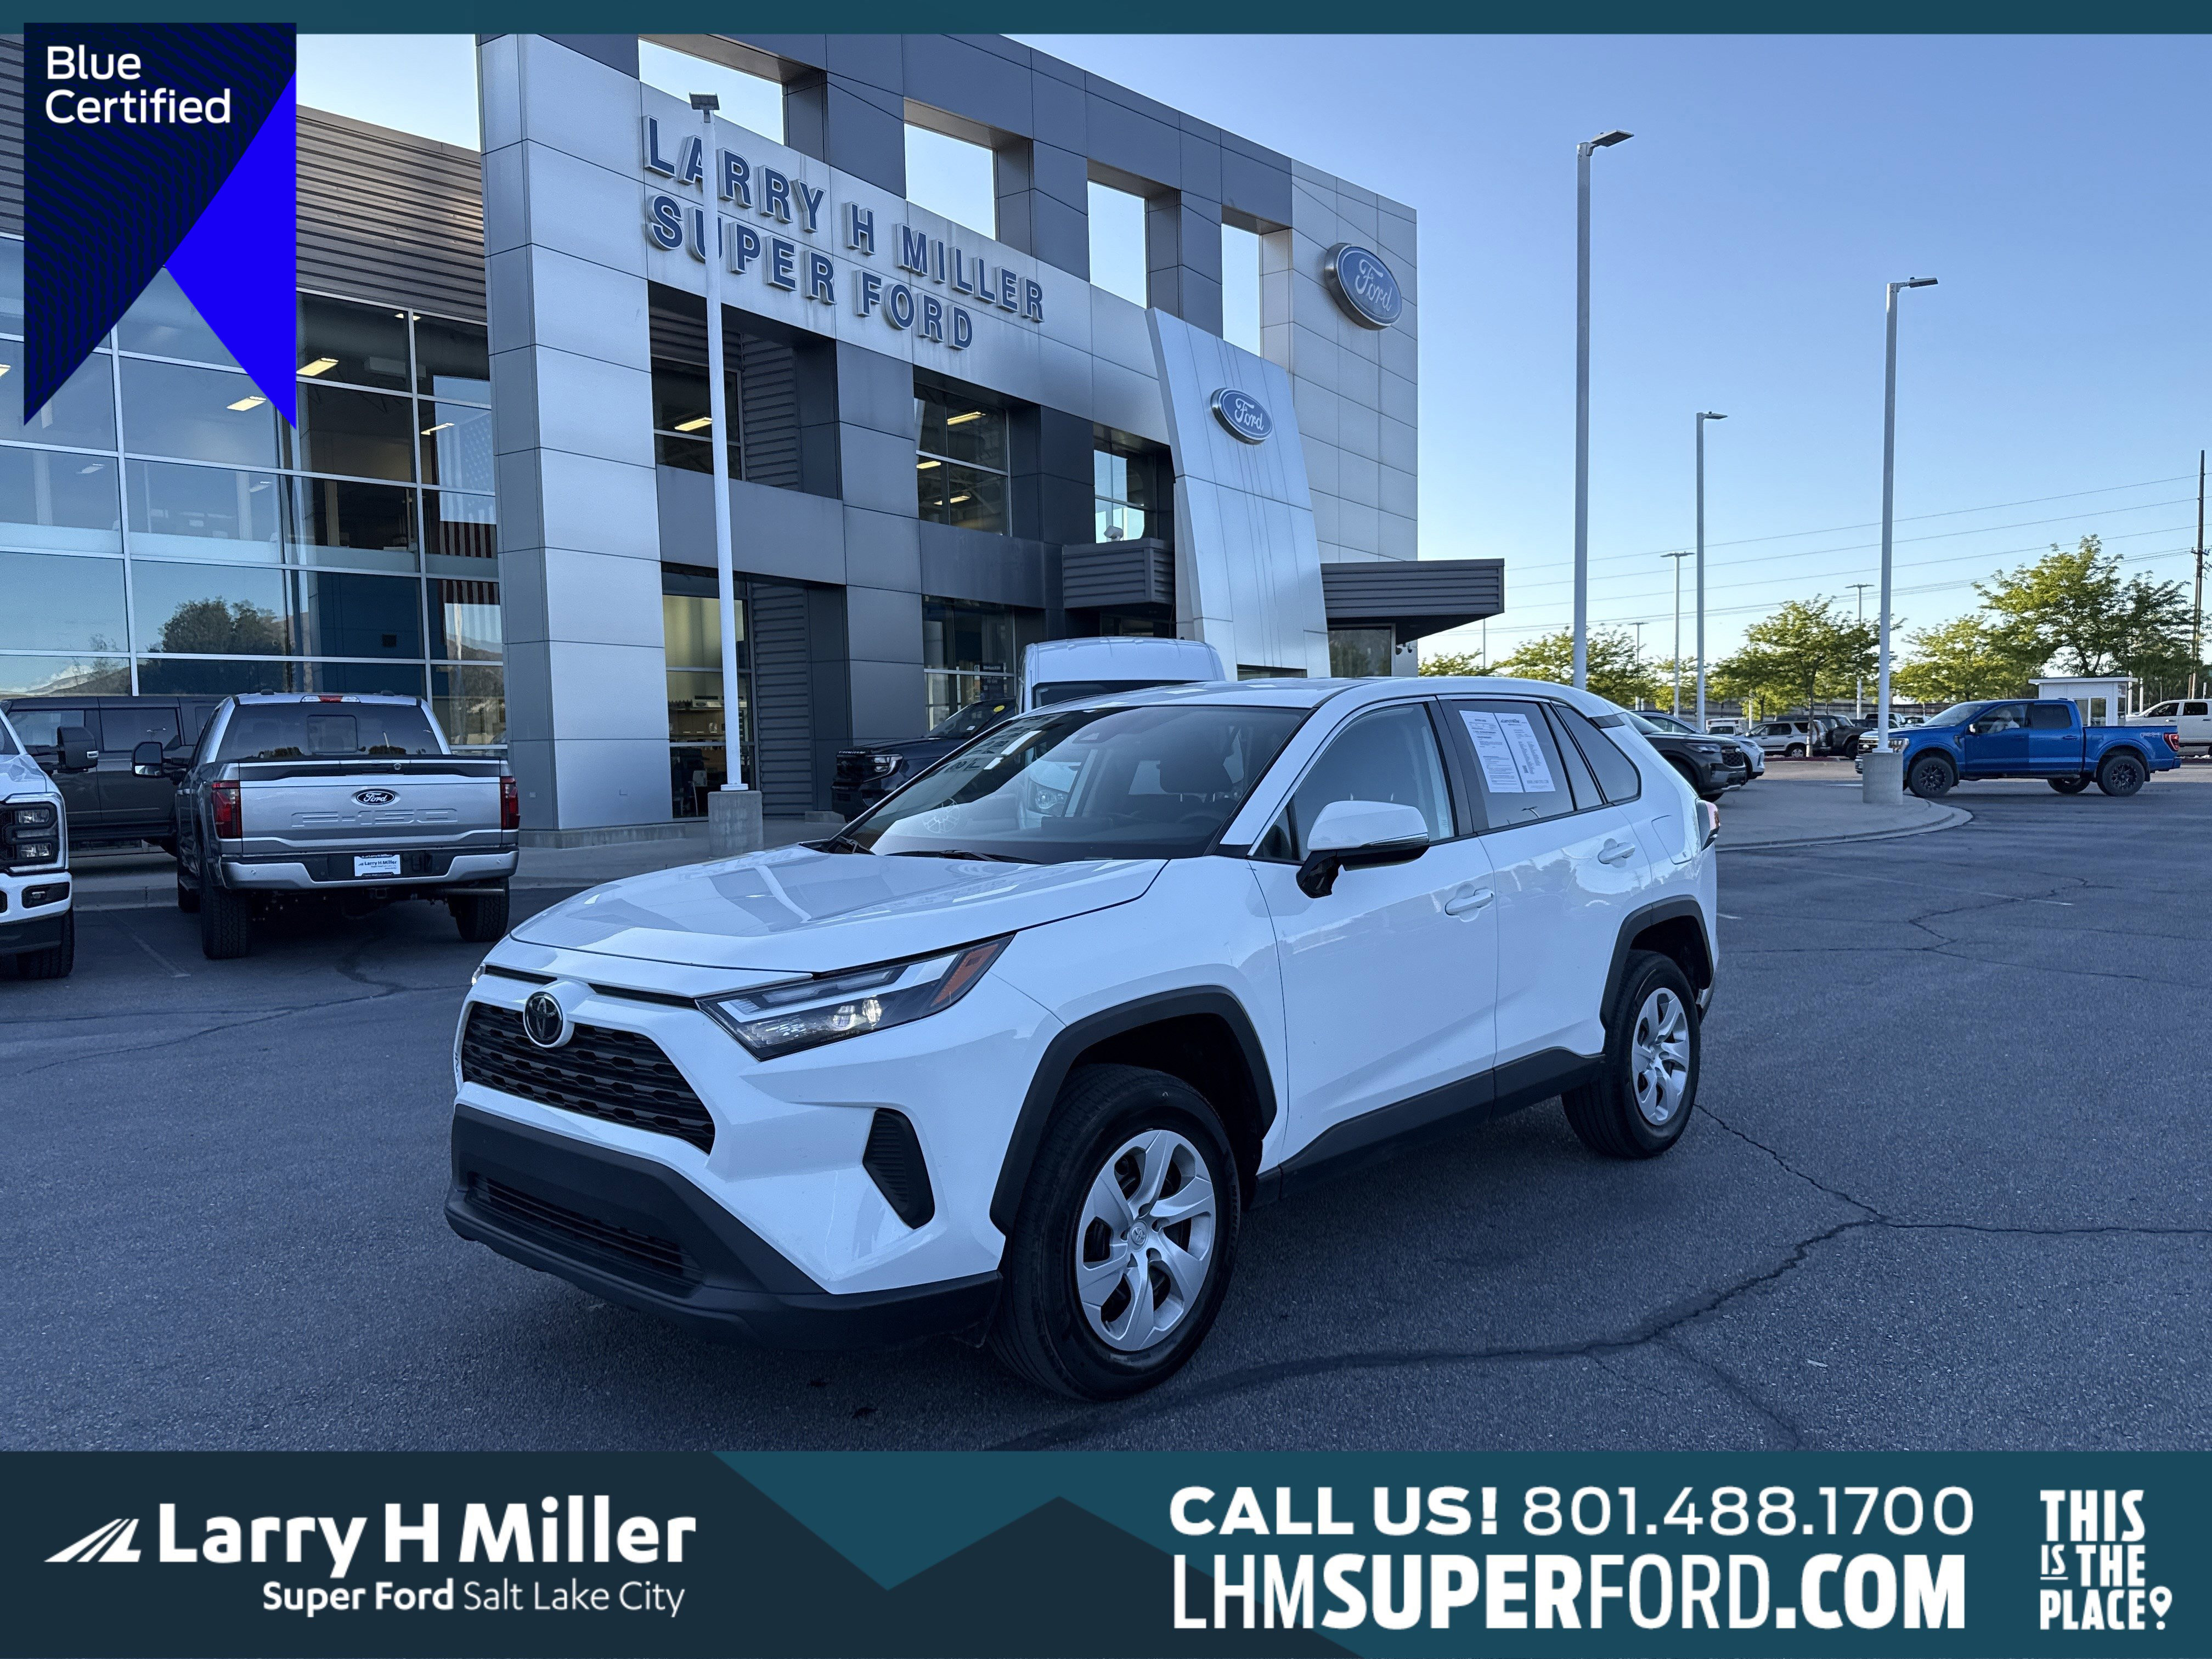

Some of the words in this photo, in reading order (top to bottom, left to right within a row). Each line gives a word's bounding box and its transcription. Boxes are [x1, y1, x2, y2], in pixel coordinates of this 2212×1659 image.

[642, 115, 826, 233] LARRY
[845, 201, 876, 256] H
[896, 223, 1045, 323] MILLER
[1355, 258, 1392, 312] Ford
[856, 269, 973, 350] FORD
[1234, 398, 1264, 431] Ford
[291, 809, 458, 827] F-150
[363, 792, 387, 803] Ford
